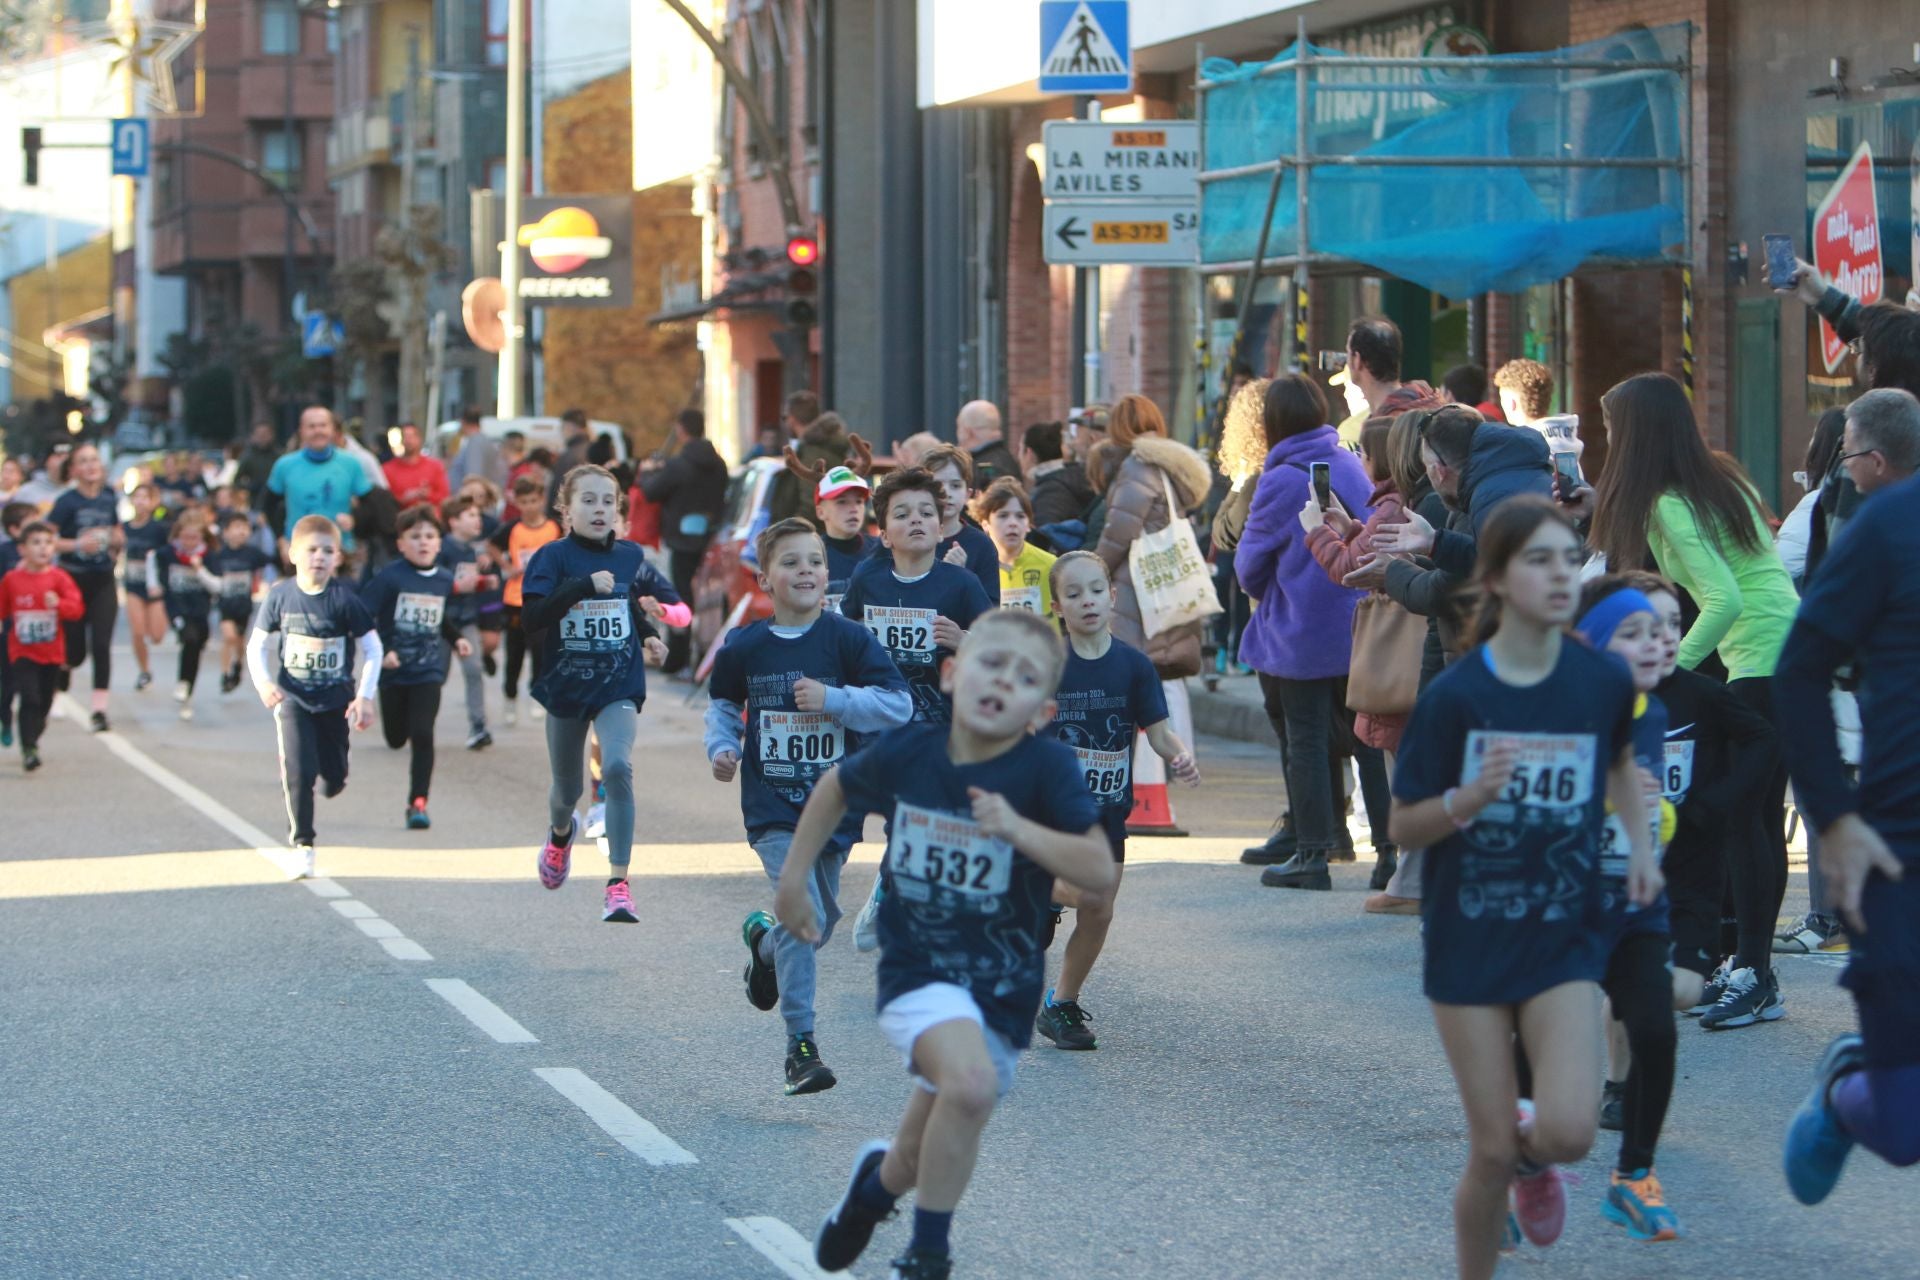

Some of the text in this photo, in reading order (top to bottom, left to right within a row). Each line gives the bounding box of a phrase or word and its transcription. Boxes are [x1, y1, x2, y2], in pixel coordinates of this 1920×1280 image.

[1053, 151, 1083, 168] LA
[1054, 174, 1142, 191] AVILES
[1097, 224, 1164, 239] AS-373
[873, 608, 927, 618] SAN SILVESTRE
[583, 618, 622, 638] 505
[886, 626, 927, 650] 652
[306, 652, 338, 669] 560
[771, 714, 834, 725] SAN SILVESTRE
[787, 733, 834, 761] 600
[1085, 767, 1125, 793] 669
[1508, 766, 1575, 803] 546
[924, 844, 993, 890] 532
